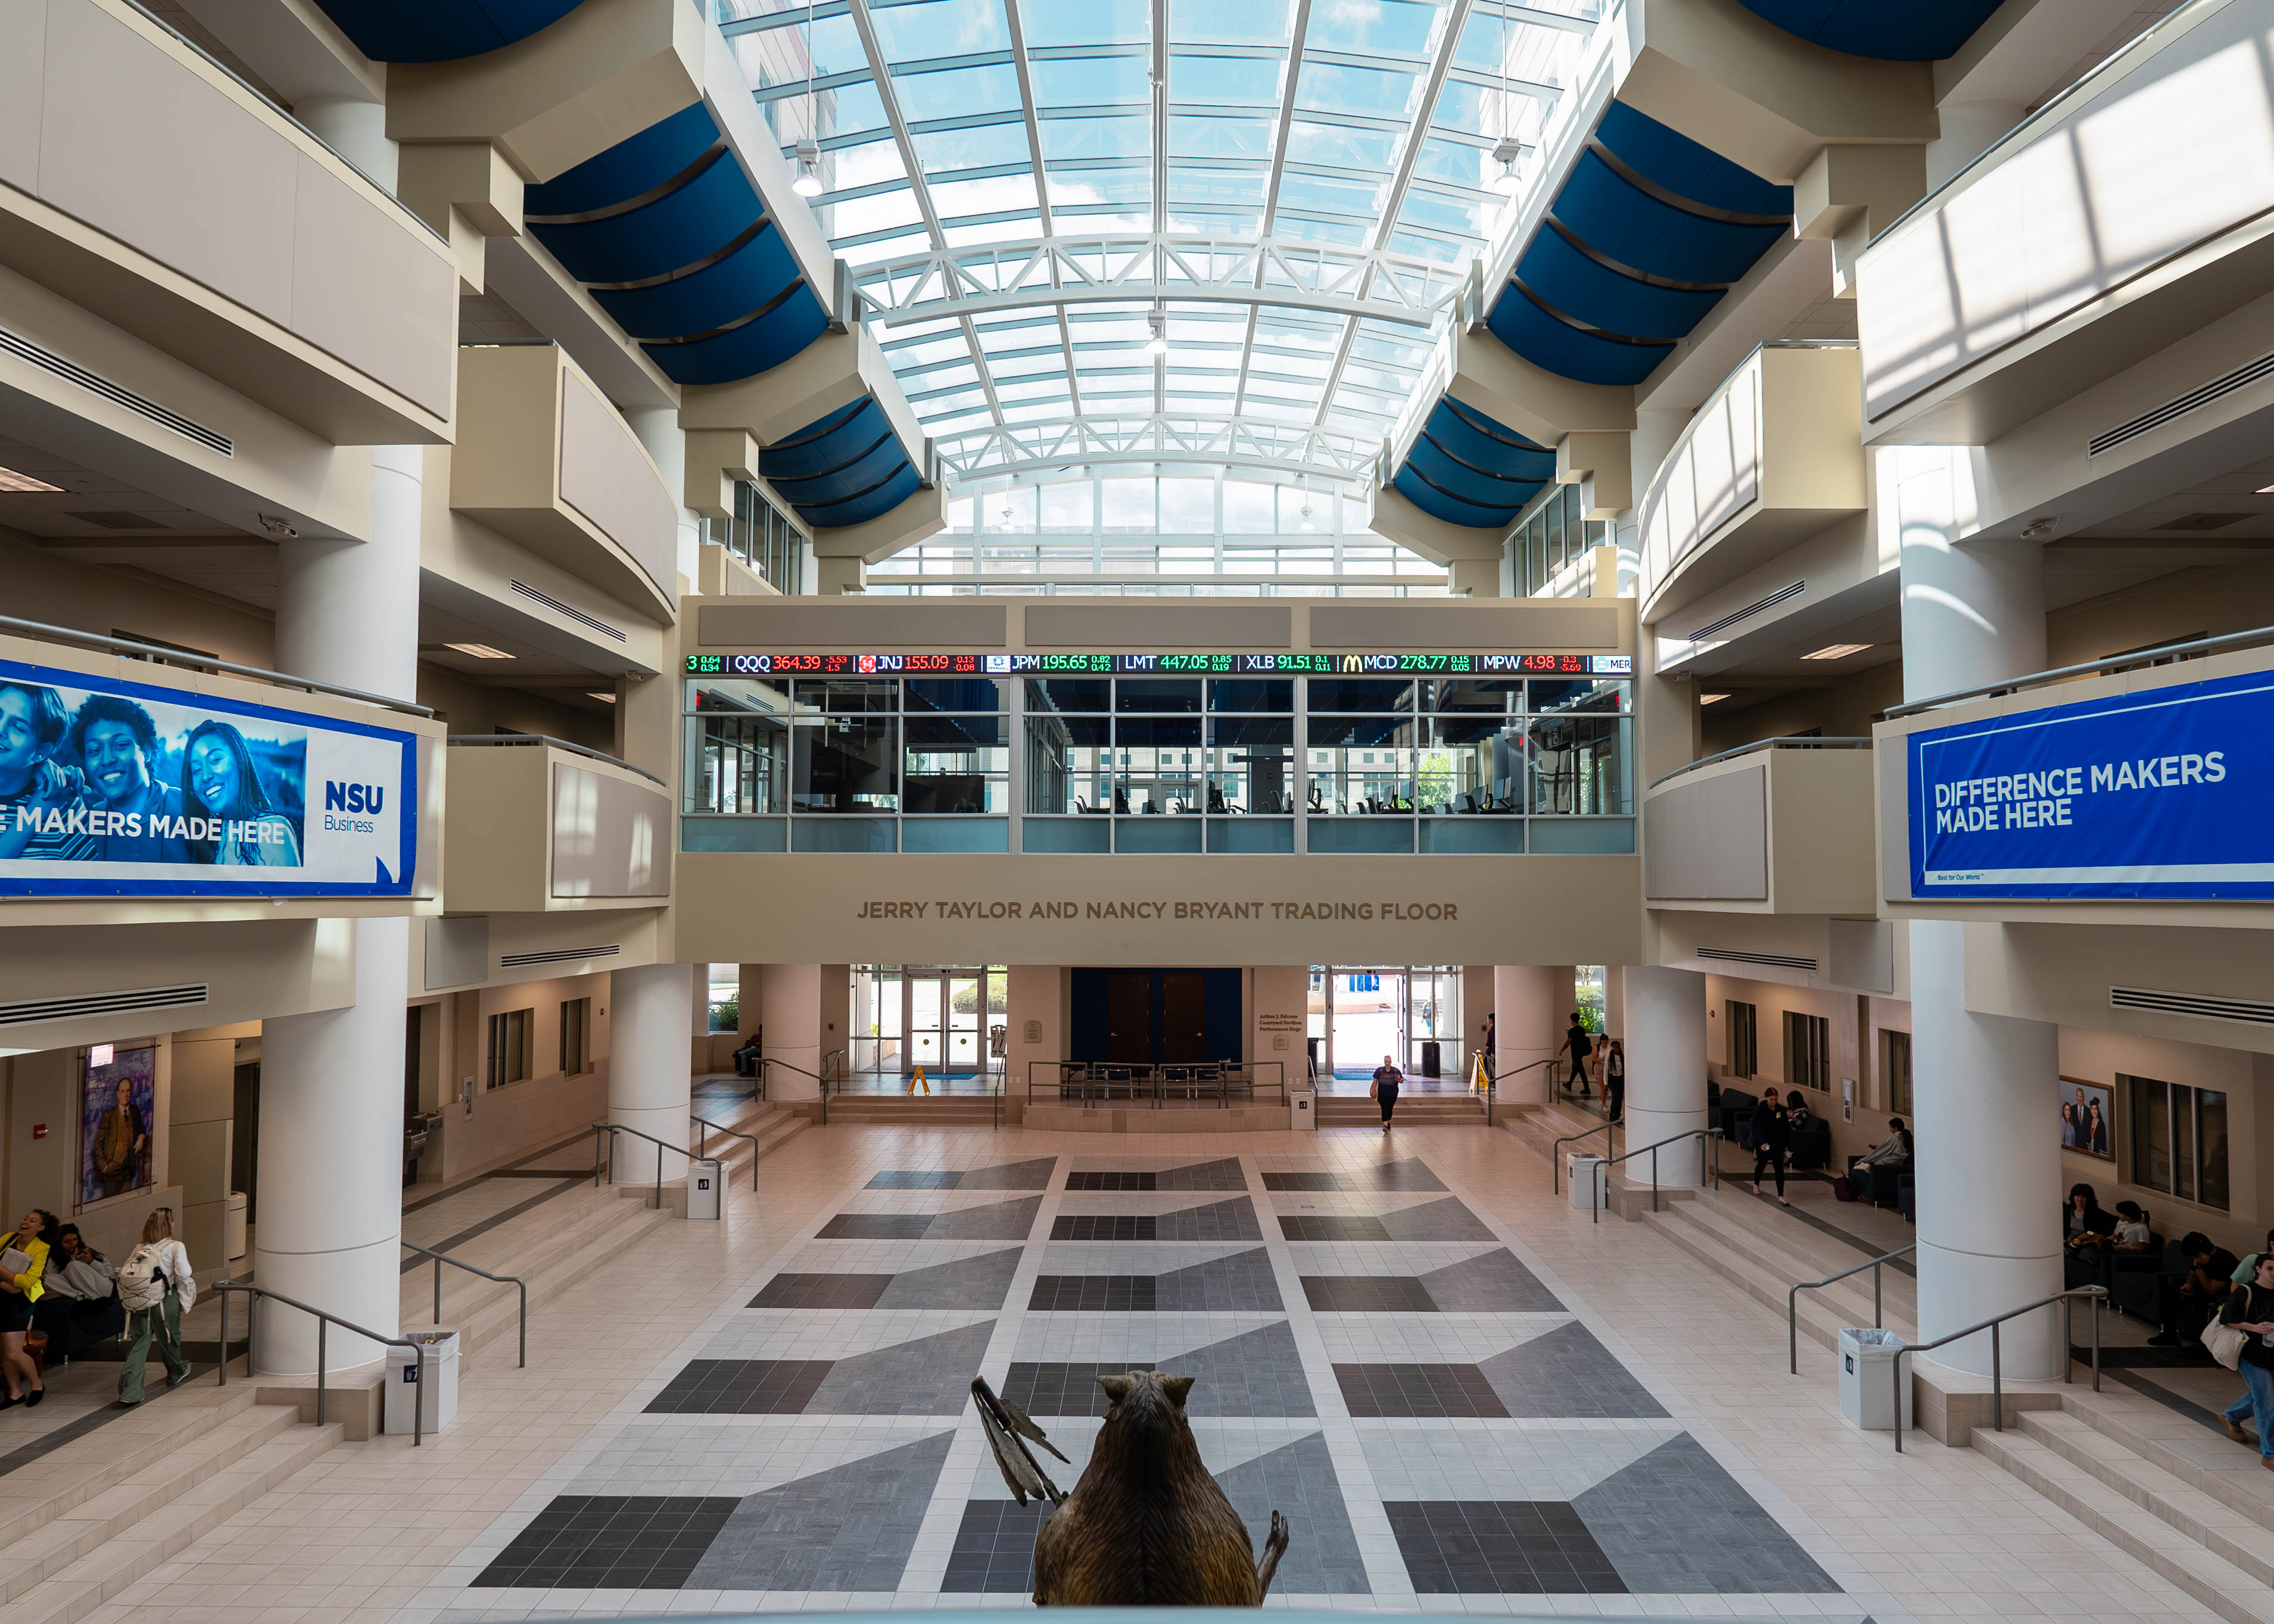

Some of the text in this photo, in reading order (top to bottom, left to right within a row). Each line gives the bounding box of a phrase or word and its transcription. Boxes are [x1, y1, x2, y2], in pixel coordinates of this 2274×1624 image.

[735, 655, 821, 672] QQQ 364.39
[878, 655, 949, 669] JNJ 155.09
[1013, 655, 1088, 669] JPM 195.65
[1125, 655, 1208, 669] LMT 447.05
[1246, 655, 1311, 669] XLB 91.51
[1365, 655, 1397, 669] MCD
[1401, 655, 1447, 669] 278.77
[1484, 655, 1555, 669] MPW 4.98
[1935, 751, 2226, 808] DIFFERENCE MAKERS
[325, 780, 384, 815] NSU
[17, 805, 142, 837] MAKERS
[149, 814, 222, 841] MADE
[228, 819, 285, 844] HERE
[325, 814, 373, 833] Business
[1936, 798, 2073, 834] MADE HERE
[857, 902, 1459, 921] JERRY TAYLOR AND NANCY BRYANT TRADING FLOOR
